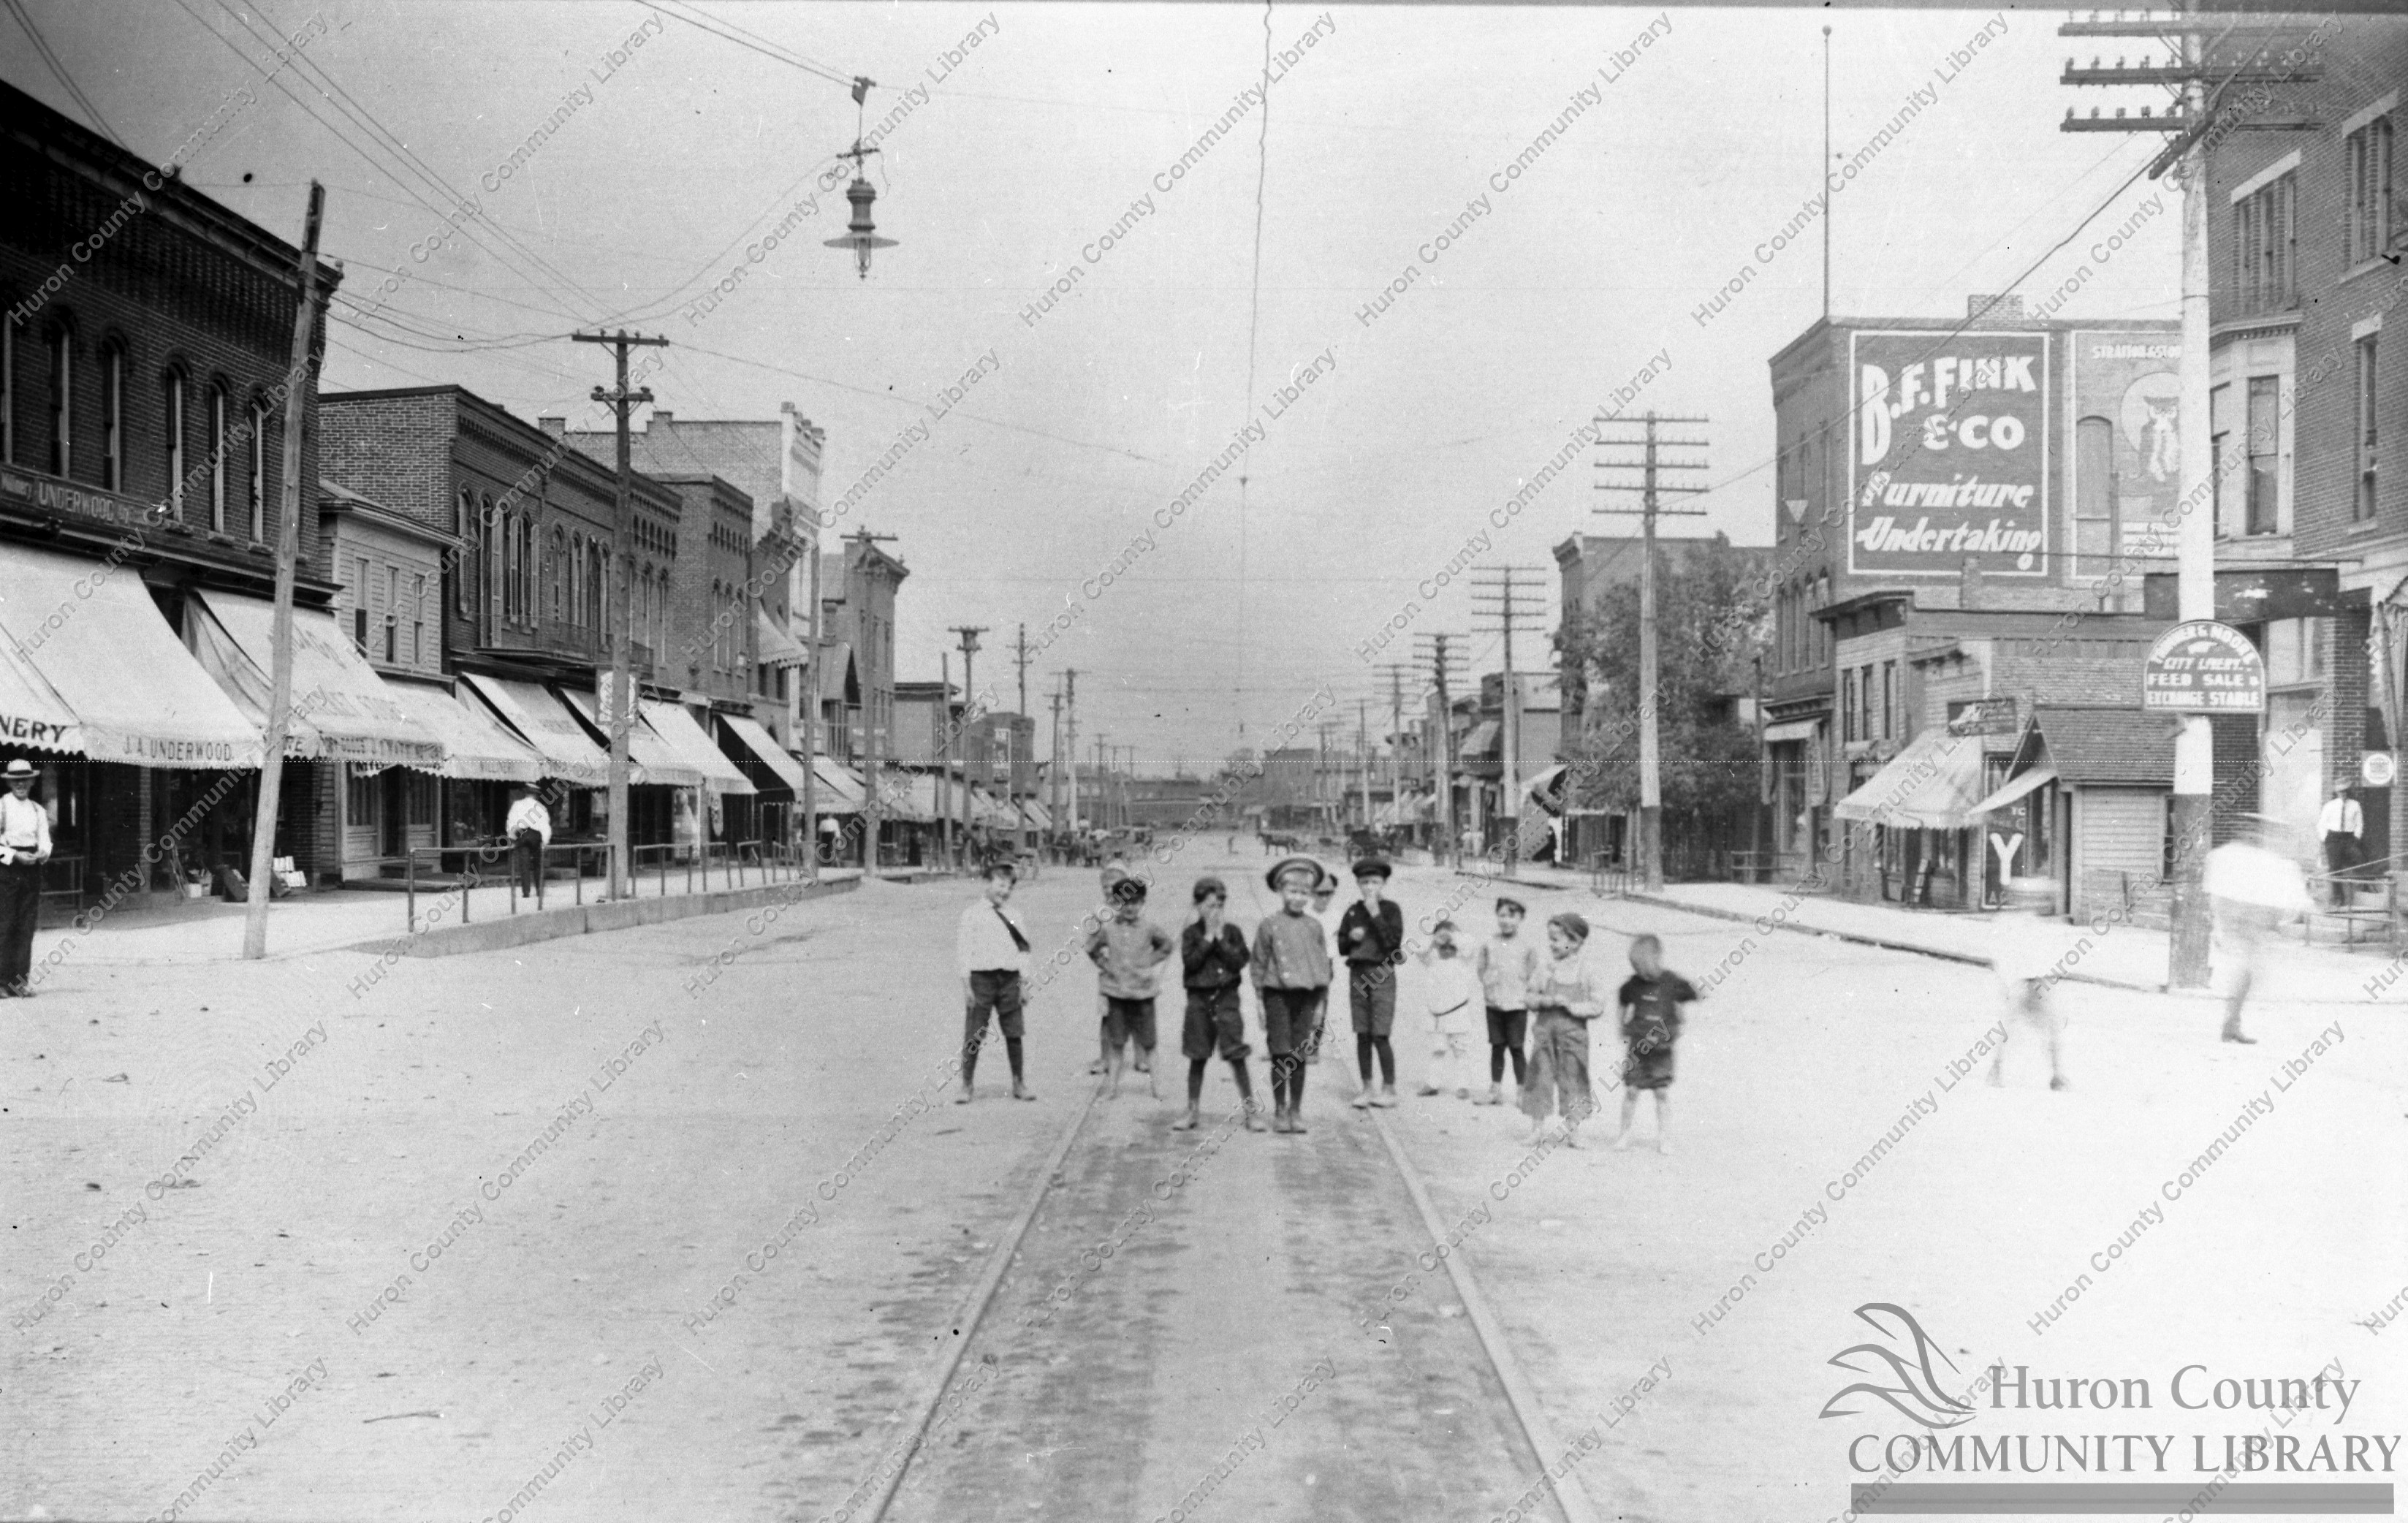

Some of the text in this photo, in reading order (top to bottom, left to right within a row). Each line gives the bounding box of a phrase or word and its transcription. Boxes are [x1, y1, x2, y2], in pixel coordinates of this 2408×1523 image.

[1934, 355, 2037, 409] FINK
[1959, 414, 2025, 450] CO
[38, 481, 115, 522] UNDERWOOD
[1862, 470, 2035, 508] Furniture
[1855, 516, 2043, 571] Undertaking
[2147, 672, 2192, 686] FEED
[2202, 673, 2244, 687] SALE
[2163, 657, 2195, 670] CITY
[2146, 690, 2260, 706] EXCHANGE STABLE
